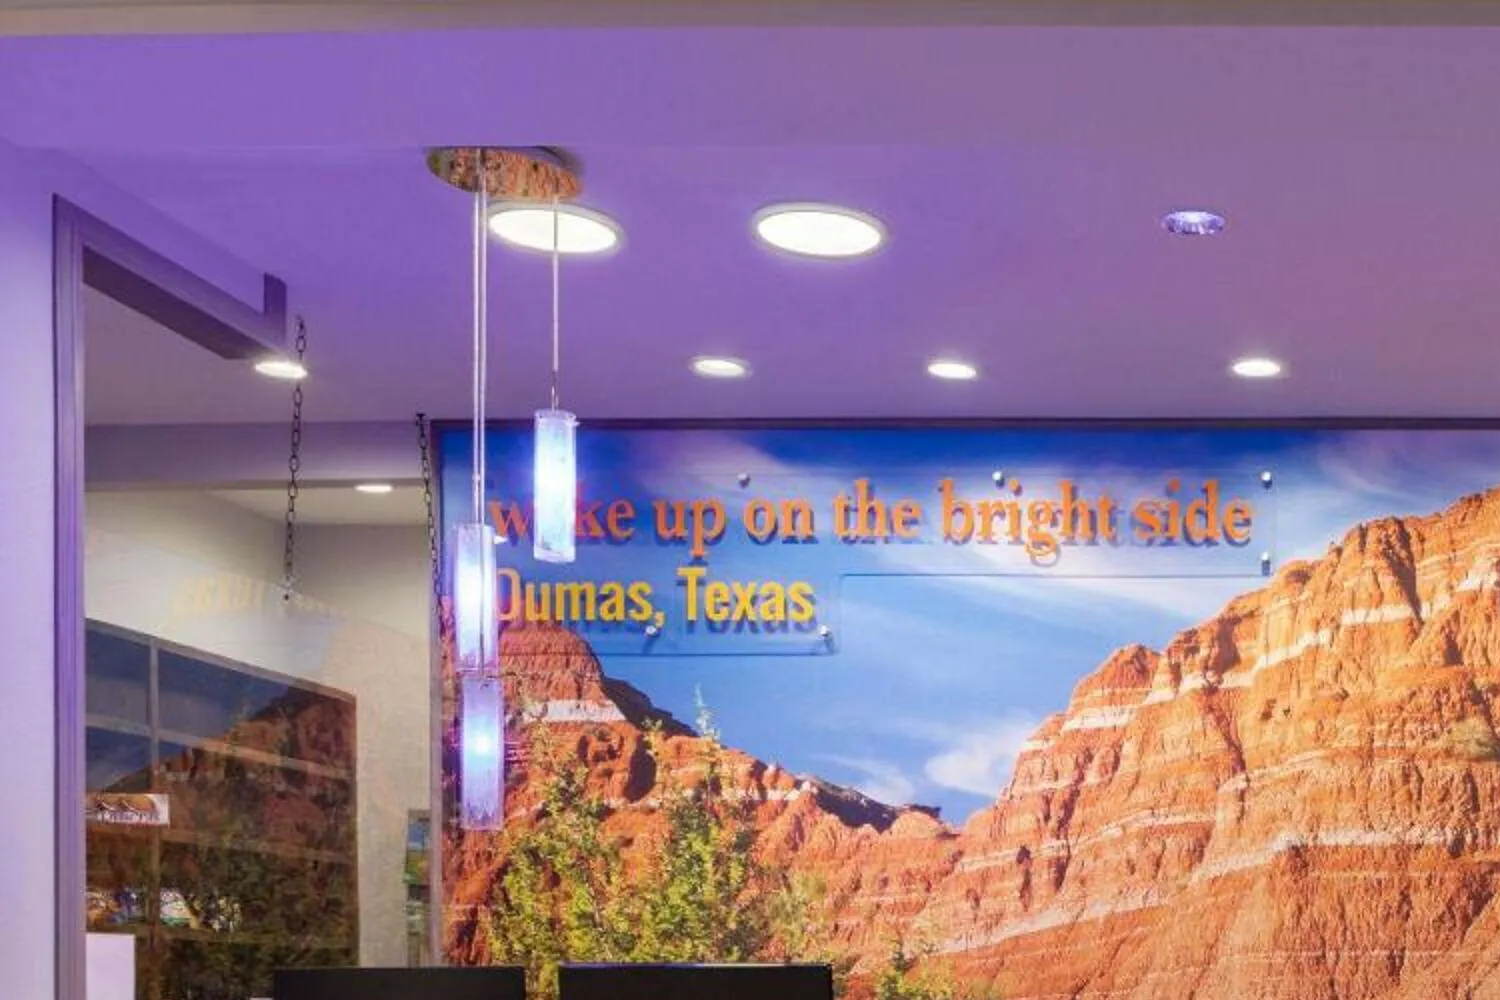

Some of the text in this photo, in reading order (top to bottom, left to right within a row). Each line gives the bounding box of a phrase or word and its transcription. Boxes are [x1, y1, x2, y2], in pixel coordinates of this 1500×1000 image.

[488, 477, 1254, 558] wke up on the bright side
[496, 566, 816, 628] Dumas, Texas
